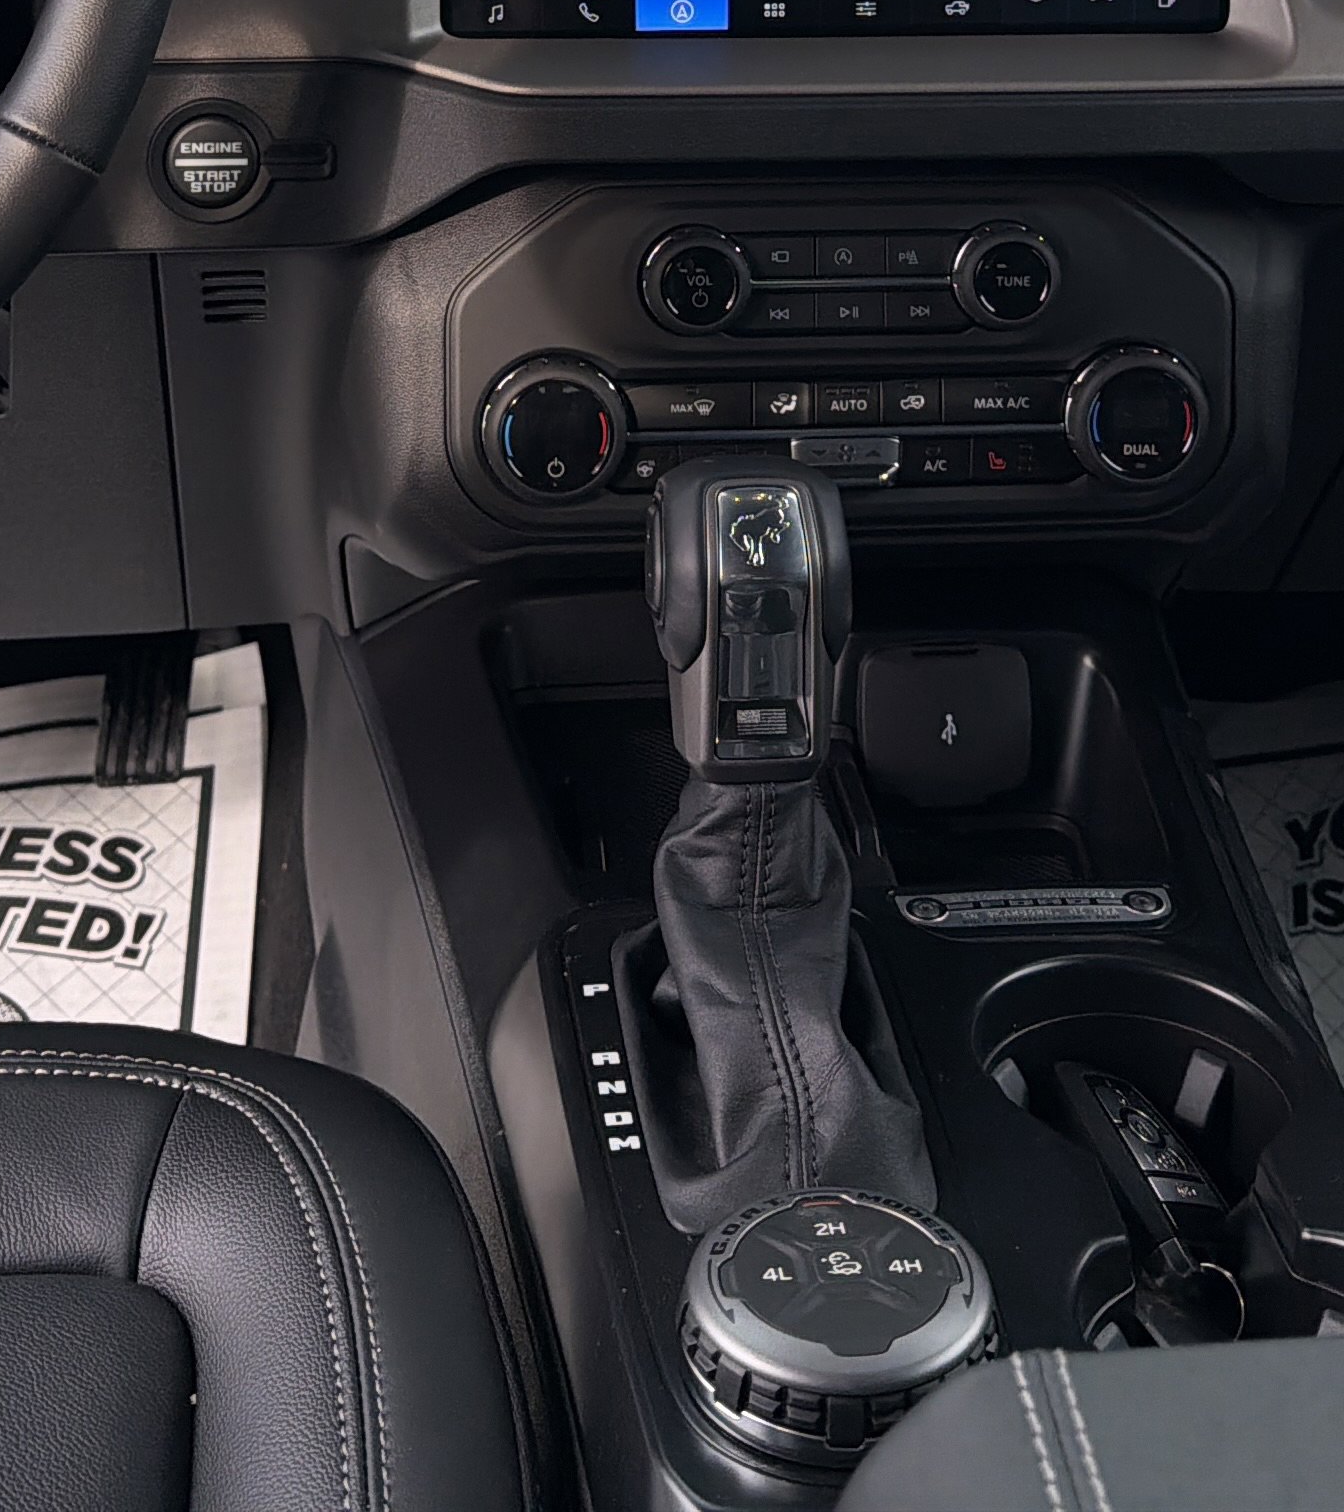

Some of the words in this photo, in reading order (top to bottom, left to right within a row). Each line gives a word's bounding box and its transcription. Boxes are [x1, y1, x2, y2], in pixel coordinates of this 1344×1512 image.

[180, 141, 243, 153] ENGINE
[183, 169, 242, 182] START
[190, 181, 236, 193] STOP
[686, 274, 713, 287] VOL
[996, 274, 1031, 287] TUNE
[670, 403, 693, 414] MAX
[830, 399, 867, 411] AUTO
[973, 397, 1004, 409] MAX
[1006, 396, 1030, 410] A/C
[1123, 443, 1159, 456] DUAL
[924, 459, 948, 472] A/C
[1290, 881, 1344, 928] IS
[583, 983, 609, 997] P
[598, 1080, 627, 1095] N
[604, 1111, 634, 1126] D
[609, 1136, 641, 1151] M
[857, 1191, 955, 1243] MODES
[814, 1222, 846, 1236] 2H
[888, 1259, 922, 1274] 4H
[762, 1267, 793, 1282] 4L
